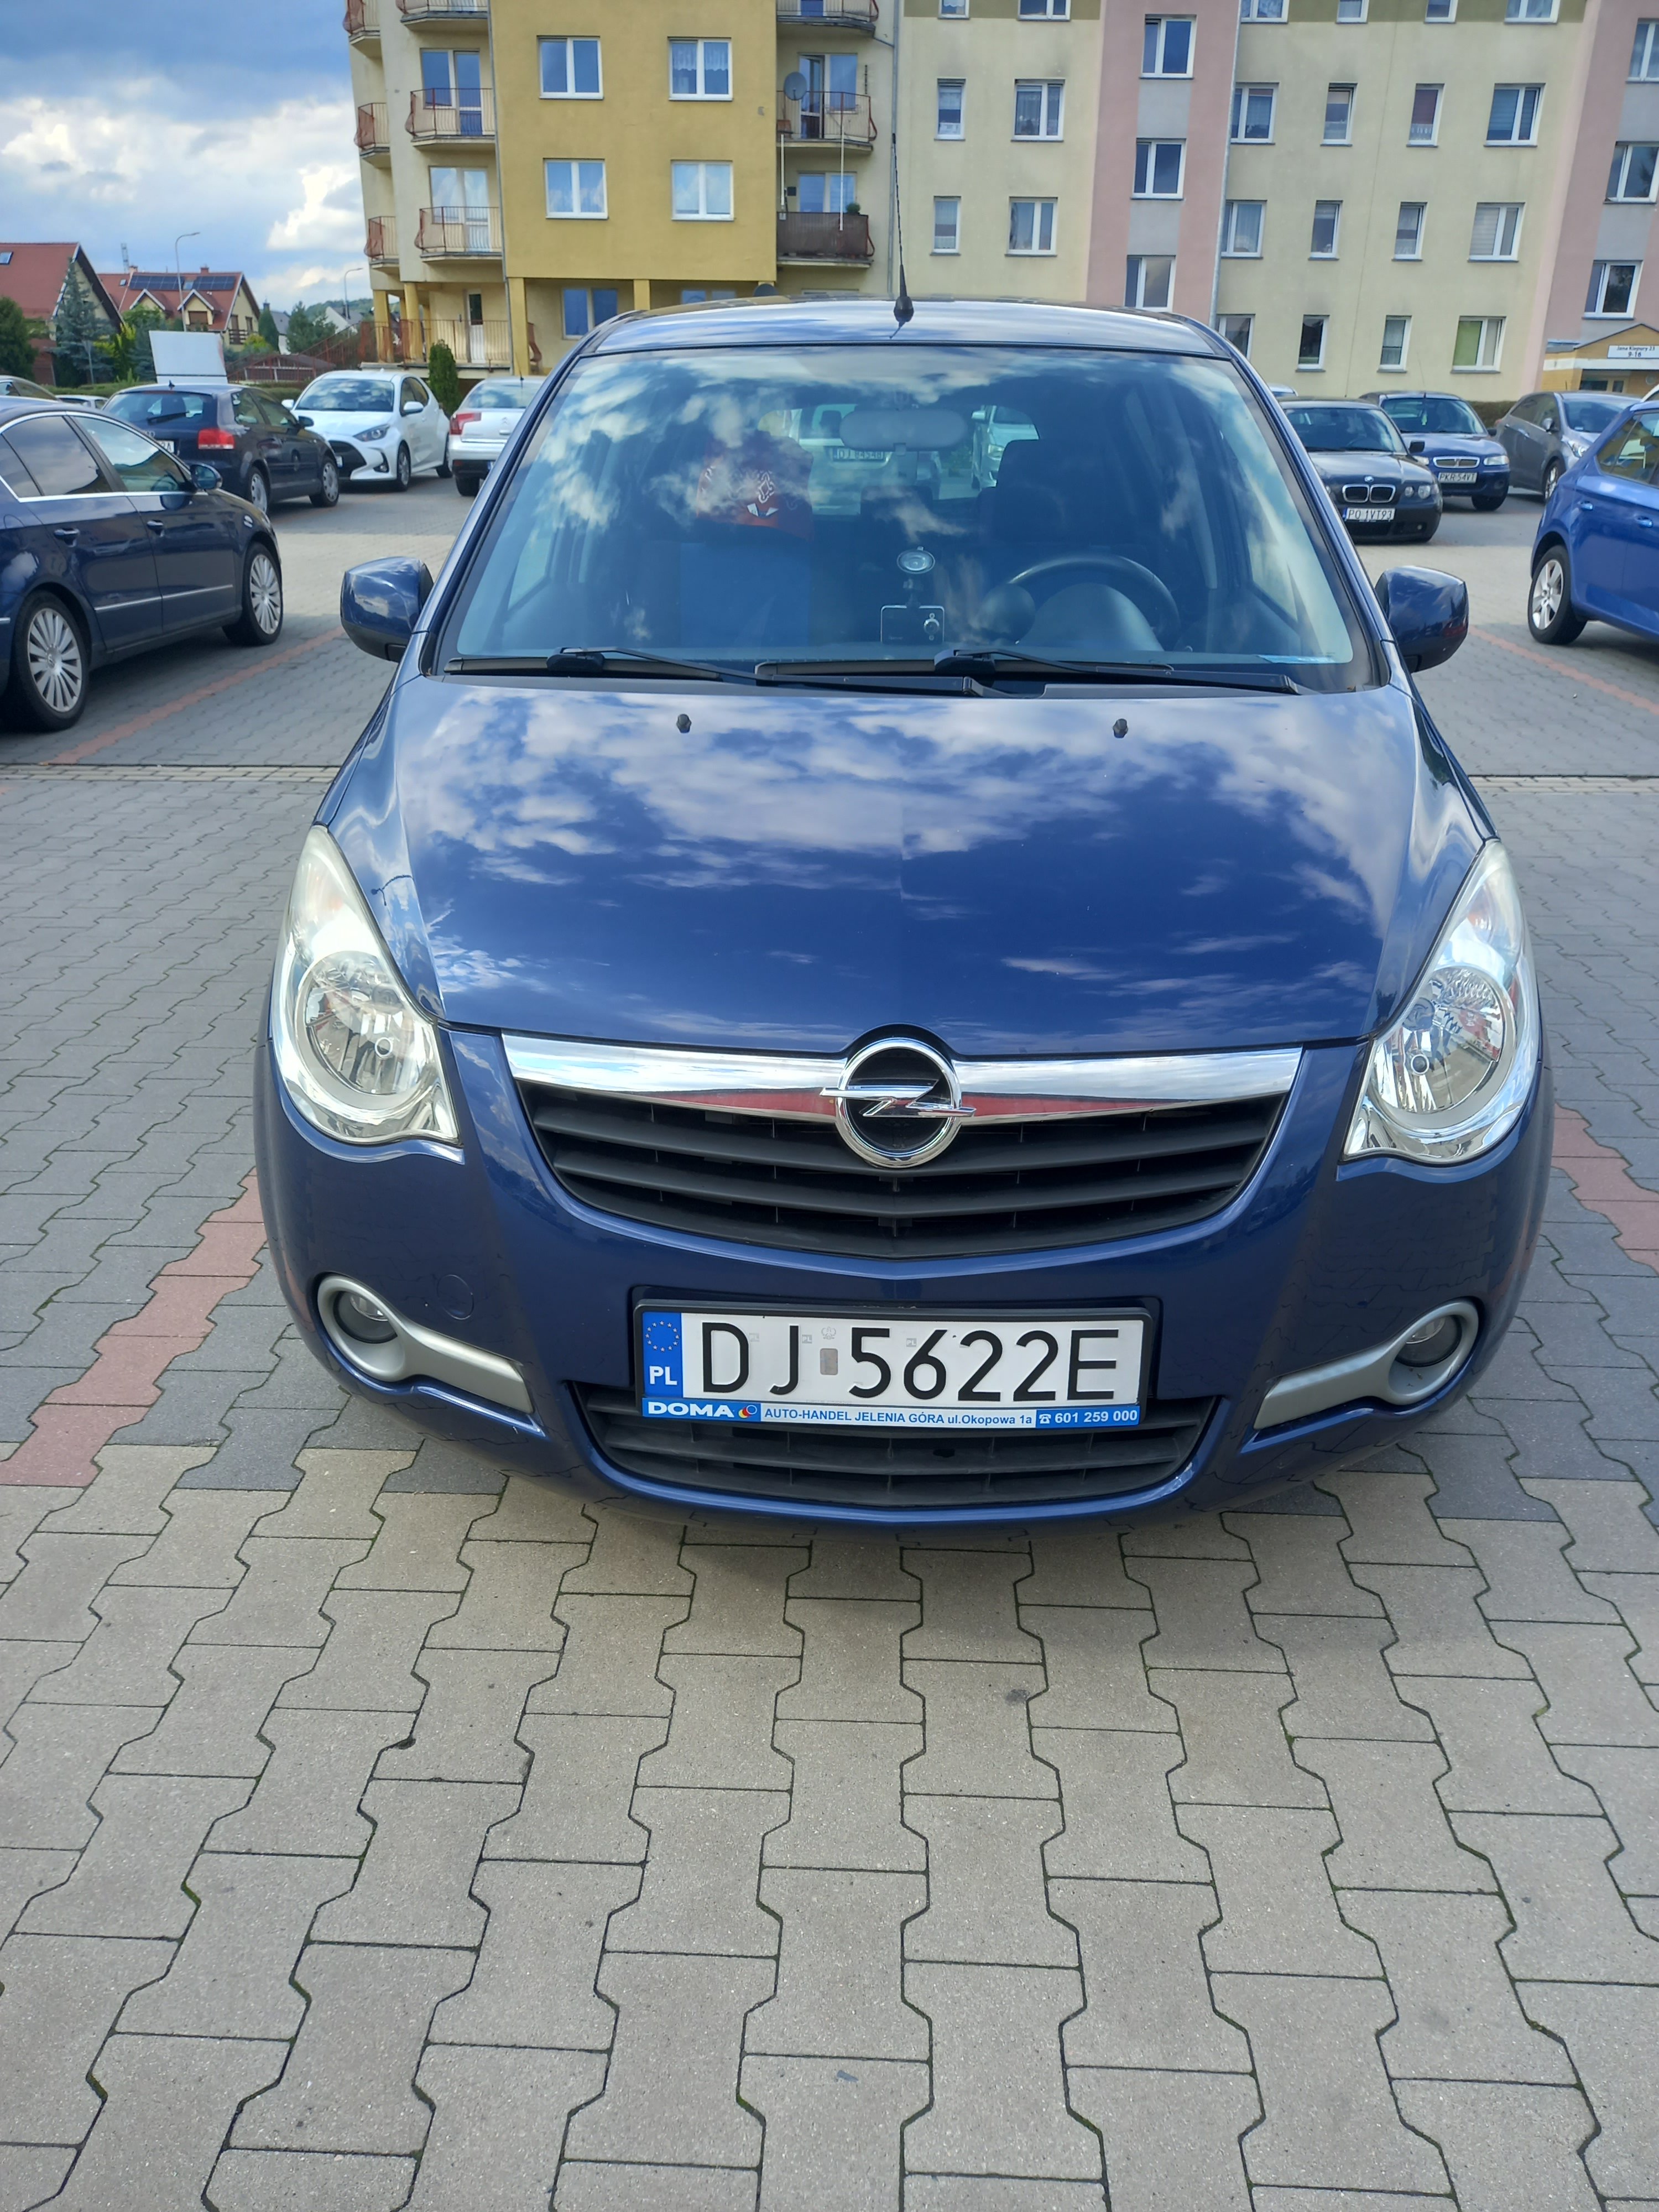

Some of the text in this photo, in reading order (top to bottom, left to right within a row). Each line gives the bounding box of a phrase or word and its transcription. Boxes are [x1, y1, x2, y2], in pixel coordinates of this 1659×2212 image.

[702, 1322, 1119, 1401] DJ 5622E
[649, 1365, 678, 1386] PL
[648, 1401, 734, 1419] DOMA
[765, 1408, 852, 1421] AUTO-HANDEL
[855, 1411, 906, 1423] JELENIA
[909, 1411, 945, 1423] GÓRA
[1019, 1415, 1032, 1425] 1a
[1054, 1410, 1138, 1423] 601 259 000
